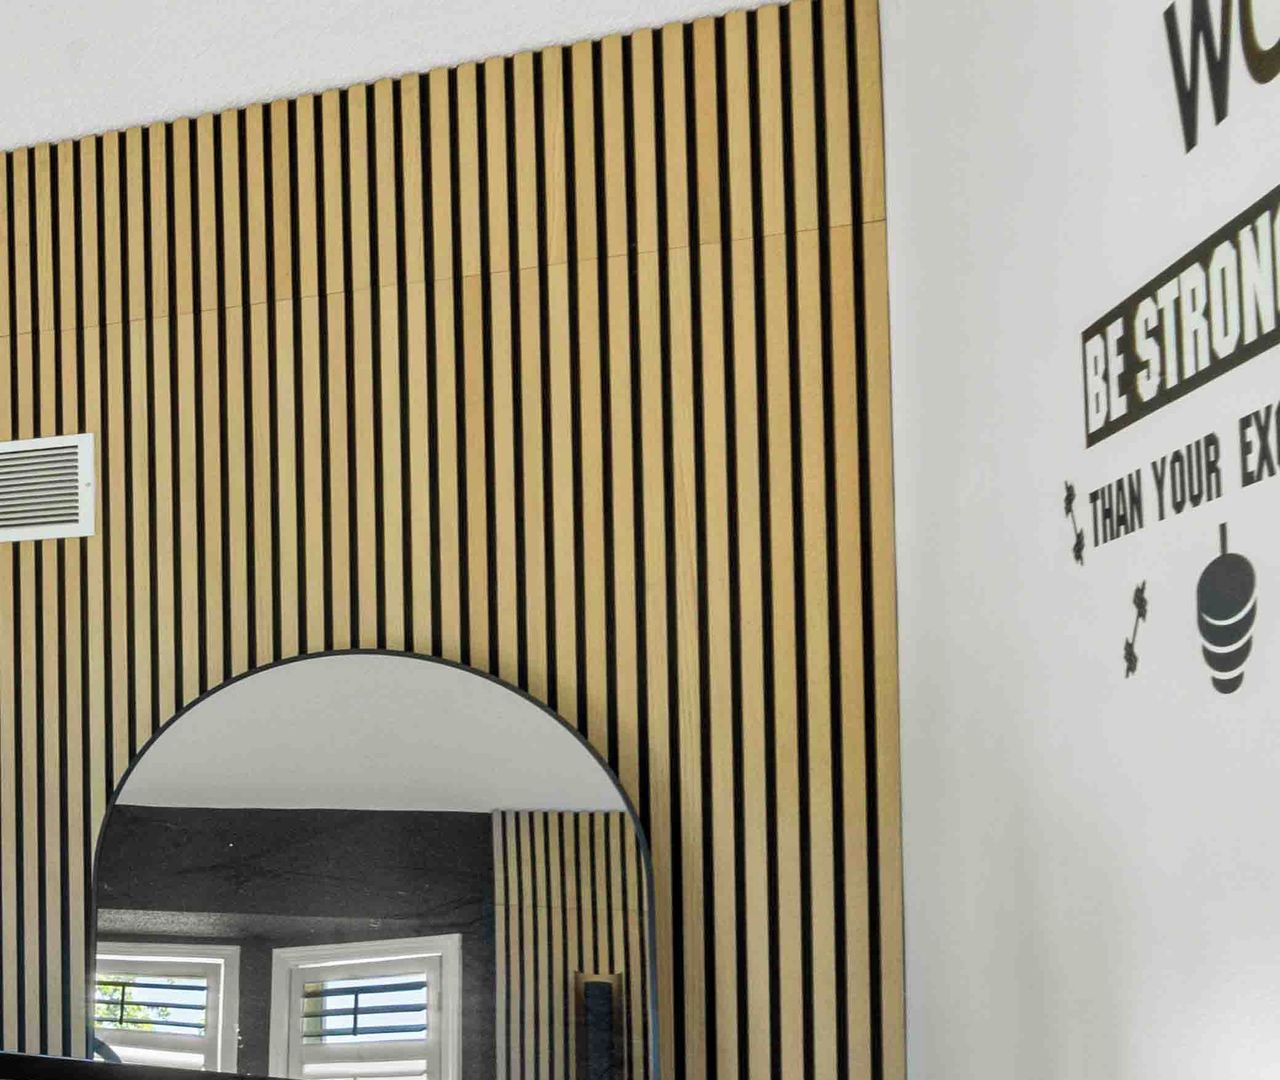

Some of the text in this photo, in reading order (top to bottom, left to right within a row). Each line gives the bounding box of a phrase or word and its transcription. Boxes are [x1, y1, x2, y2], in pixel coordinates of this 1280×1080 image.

[1085, 203, 1280, 434] BE STRON
[1089, 399, 1280, 547] THAN YOUR EX
